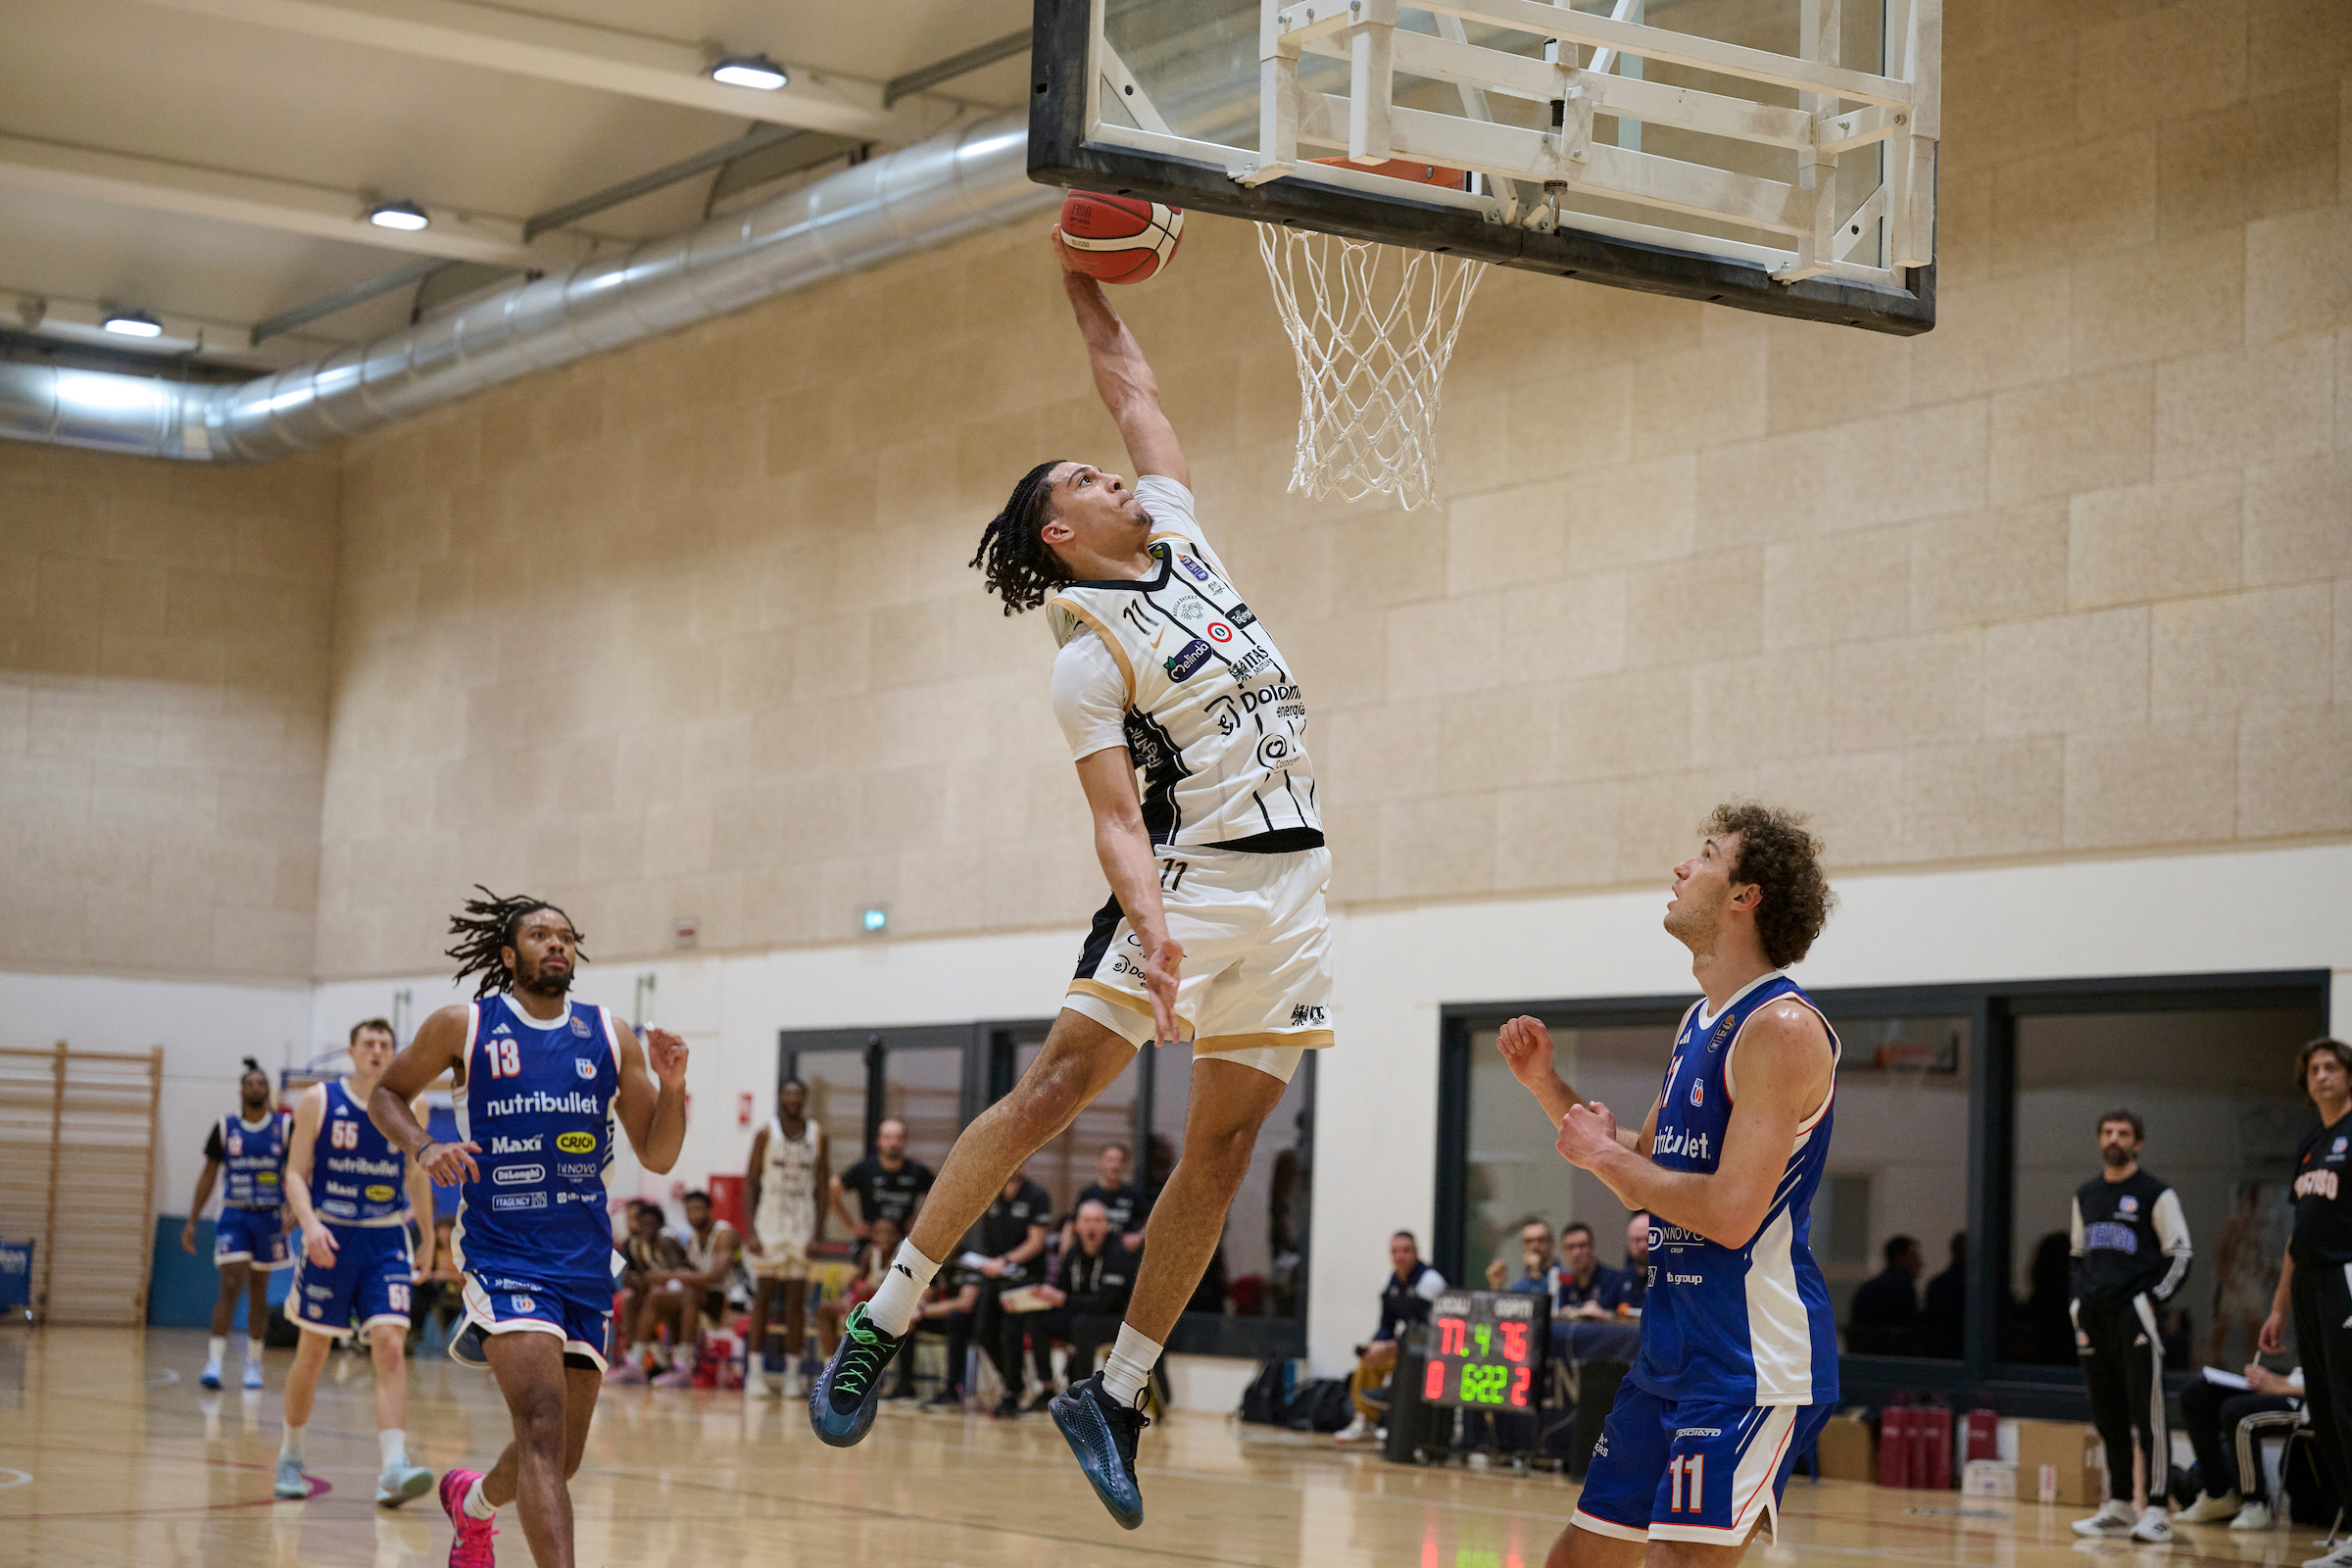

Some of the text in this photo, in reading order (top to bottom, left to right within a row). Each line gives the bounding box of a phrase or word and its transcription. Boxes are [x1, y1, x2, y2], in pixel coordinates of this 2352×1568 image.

[1170, 643, 1209, 680] Melinda
[1242, 645, 1269, 669] ITAS
[484, 1038, 520, 1079] 13
[487, 1091, 599, 1117] nutribullet
[331, 1119, 359, 1150] 55
[492, 1134, 543, 1154] Maxi
[498, 1163, 597, 1181] DeLonghi INNOVO
[1675, 1274, 1703, 1285] group
[1510, 1366, 1532, 1406] 2
[1669, 1453, 1703, 1513] 11
